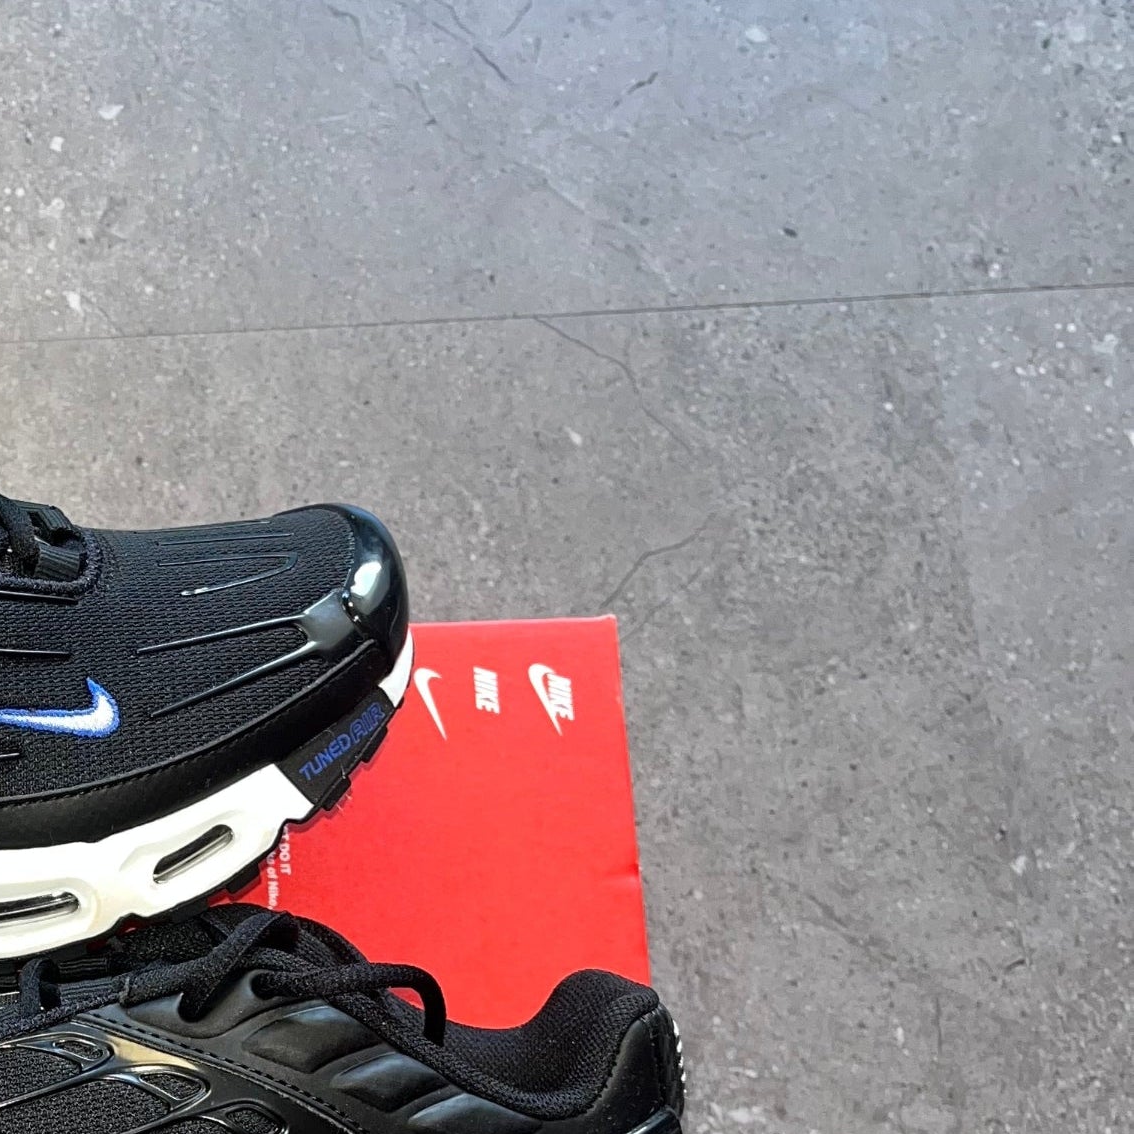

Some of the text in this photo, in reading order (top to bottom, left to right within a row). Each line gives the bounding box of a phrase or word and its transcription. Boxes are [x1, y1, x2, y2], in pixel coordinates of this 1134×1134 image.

[473, 666, 500, 714] NIKE
[547, 673, 574, 720] NIKE
[299, 702, 385, 780] TUNED AIR
